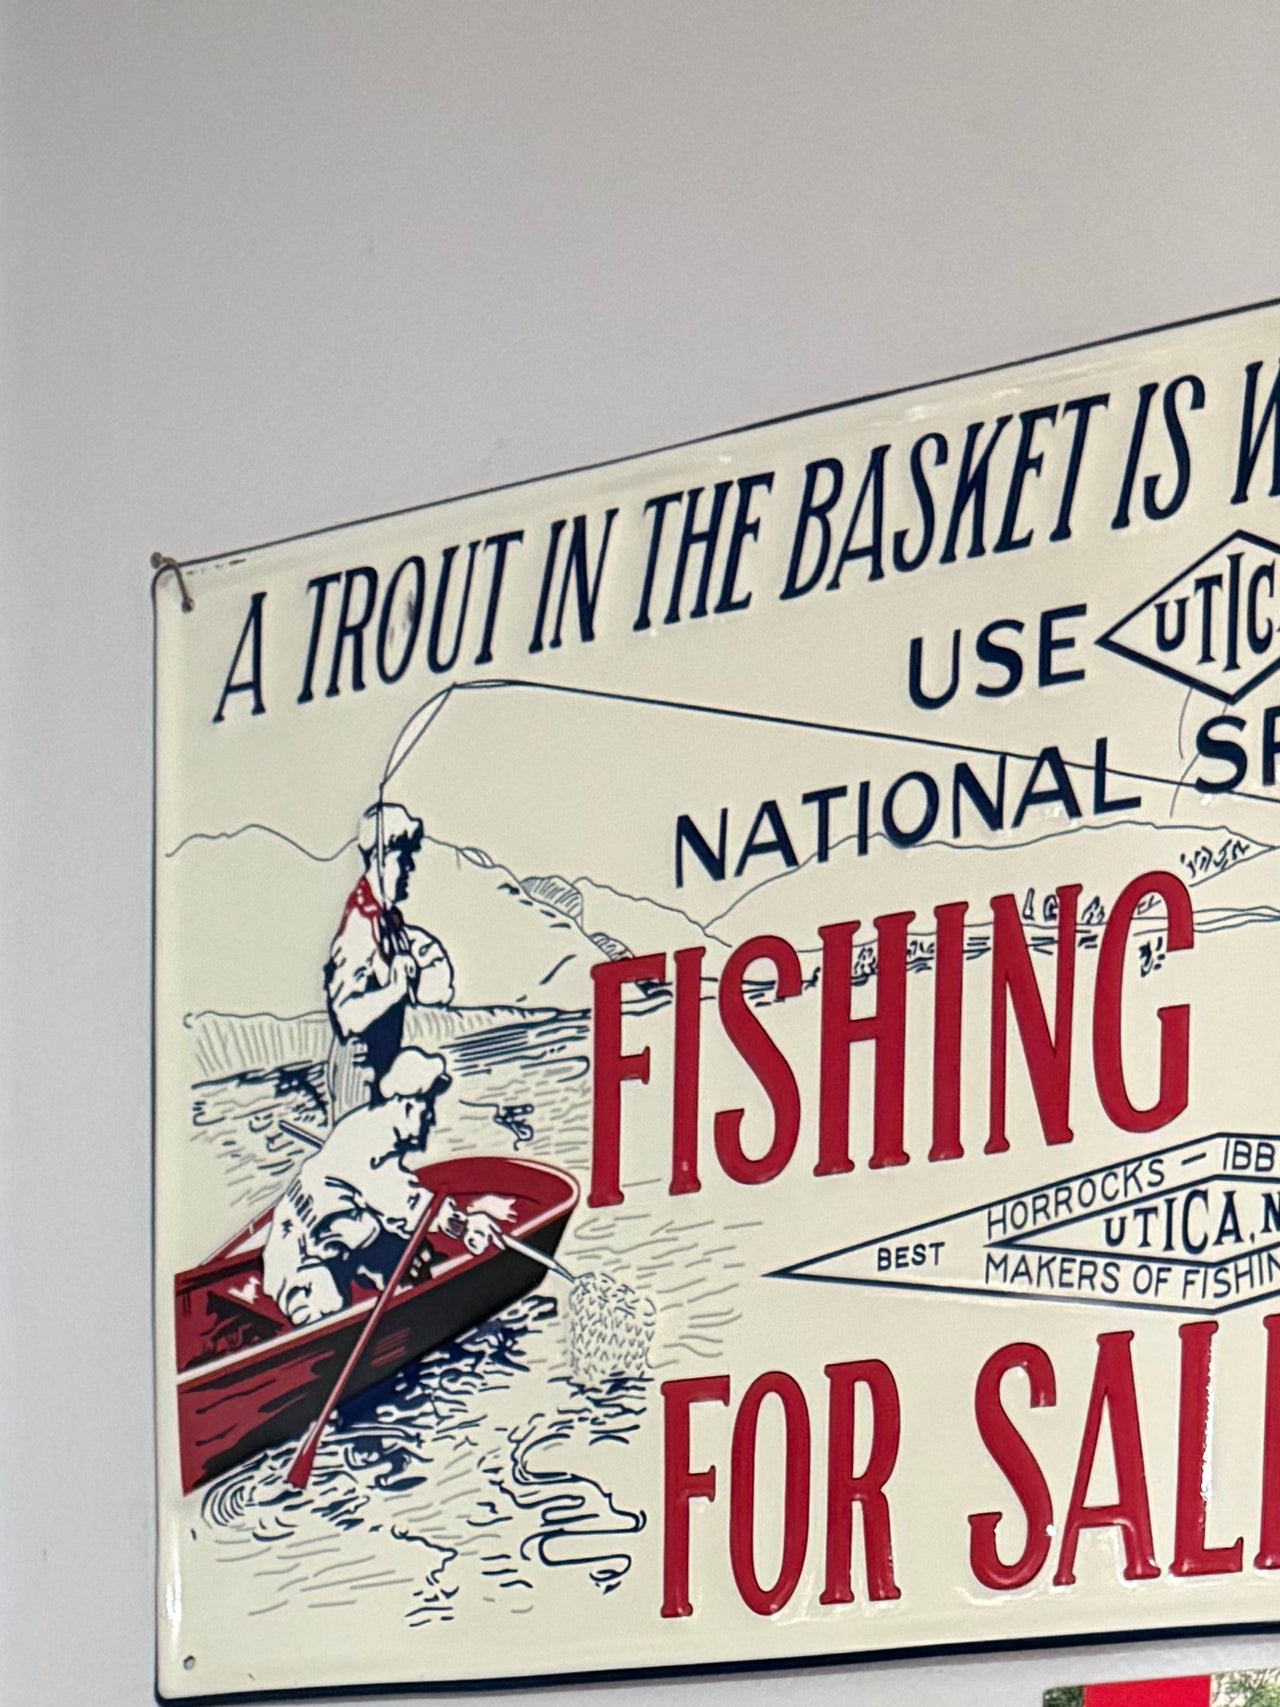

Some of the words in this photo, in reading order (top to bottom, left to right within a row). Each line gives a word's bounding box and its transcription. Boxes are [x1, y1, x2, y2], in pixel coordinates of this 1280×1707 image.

[213, 591, 268, 724] A
[297, 530, 525, 704] TROUT
[528, 508, 623, 653] IN
[628, 470, 774, 630] THE
[780, 394, 1108, 603] BASKET
[1111, 373, 1206, 531] IS
[908, 605, 1088, 709] USE
[673, 736, 1142, 889] NATIONAL
[587, 871, 1194, 1208] FISHING
[876, 1243, 946, 1271] BEST
[985, 1158, 1166, 1240] HORROCKS
[985, 1251, 1122, 1295] MAKERS
[1131, 1263, 1174, 1299] OF
[658, 1358, 904, 1618] FOR
